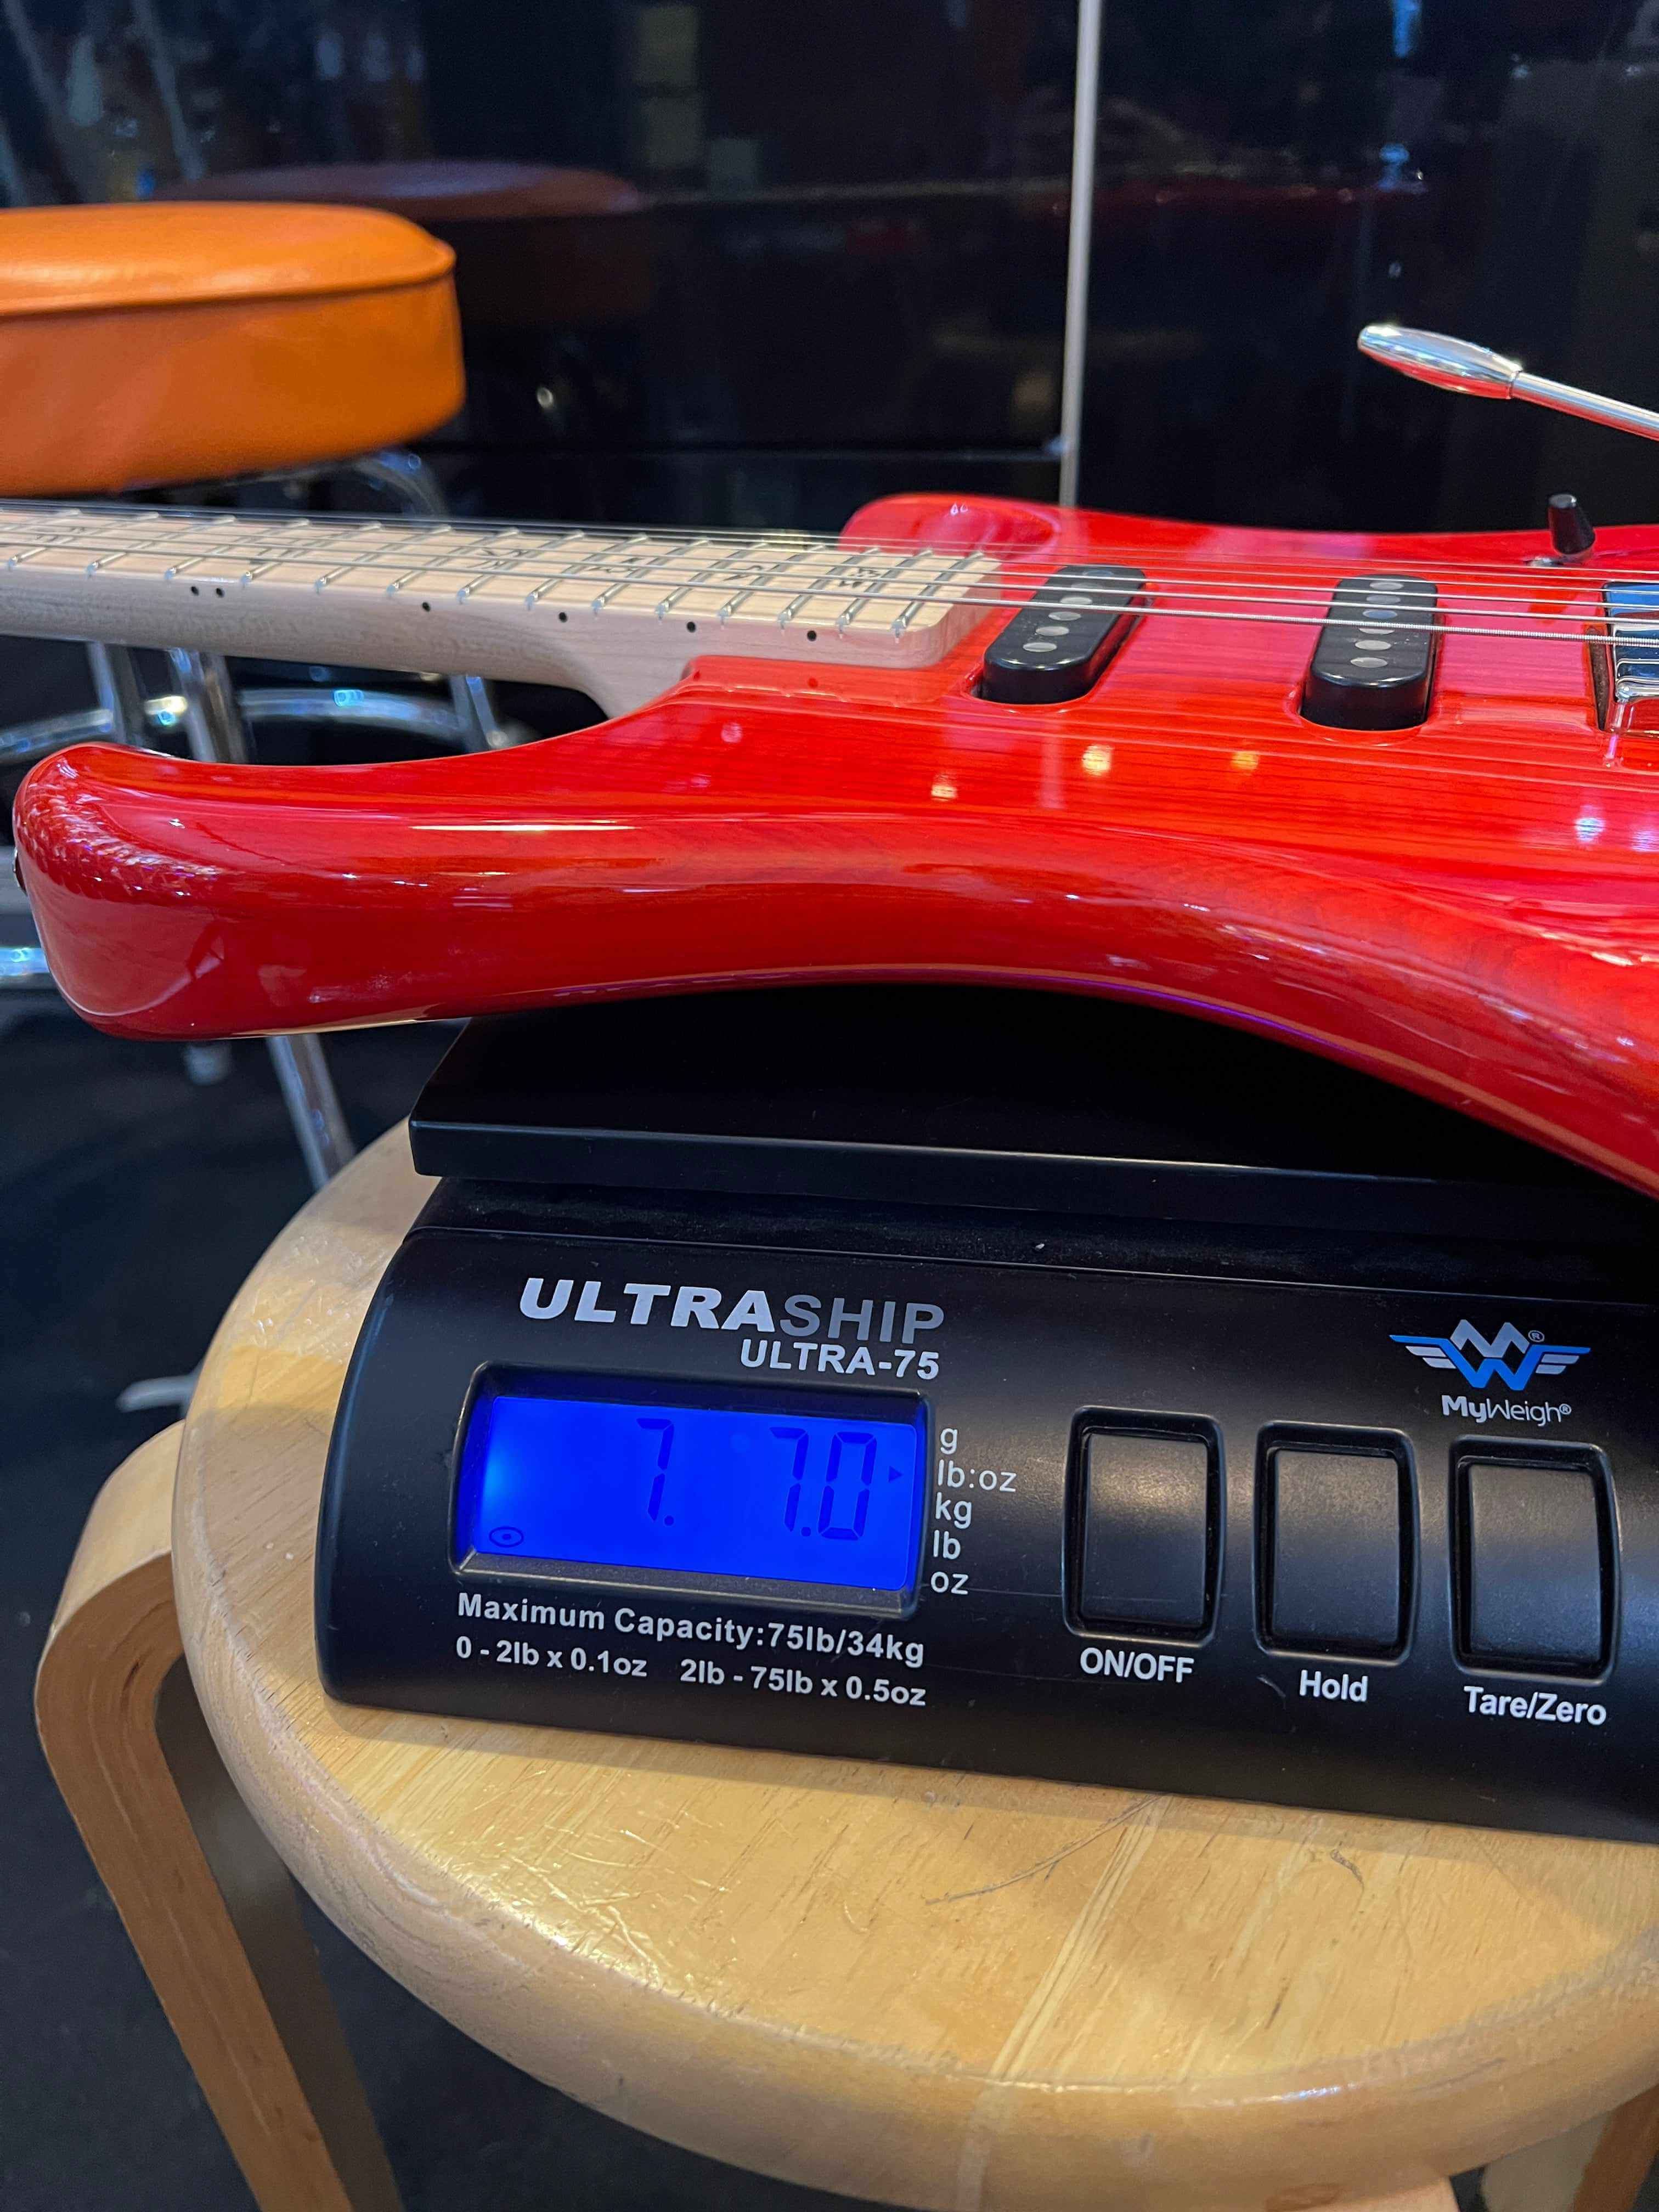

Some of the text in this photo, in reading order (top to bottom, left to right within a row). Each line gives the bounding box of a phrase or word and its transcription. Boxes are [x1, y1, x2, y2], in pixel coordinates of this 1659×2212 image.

[519, 1277, 945, 1345] ULTRASHIP
[741, 1339, 940, 1380] ULTRA-75
[940, 1427, 958, 1455] g
[769, 1426, 878, 1542] 7.0
[937, 1459, 1017, 1492] lb:oz
[935, 1492, 973, 1528] kg
[933, 1530, 961, 1560] lb
[930, 1571, 969, 1595] oz
[458, 1592, 605, 1630] Maximum
[456, 1636, 472, 1658] 0
[496, 1640, 539, 1665] 2lb
[547, 1650, 563, 1668] x
[571, 1647, 647, 1677] 0.1oz
[680, 1658, 724, 1684] 2lb
[751, 1666, 812, 1694] 75lb
[821, 1679, 838, 1697] x
[846, 1676, 926, 1706] 0.5oz
[1079, 1646, 1195, 1683] ON/OFF
[1299, 1669, 1368, 1702] Hold
[1463, 1685, 1607, 1726] Tare/Zero
